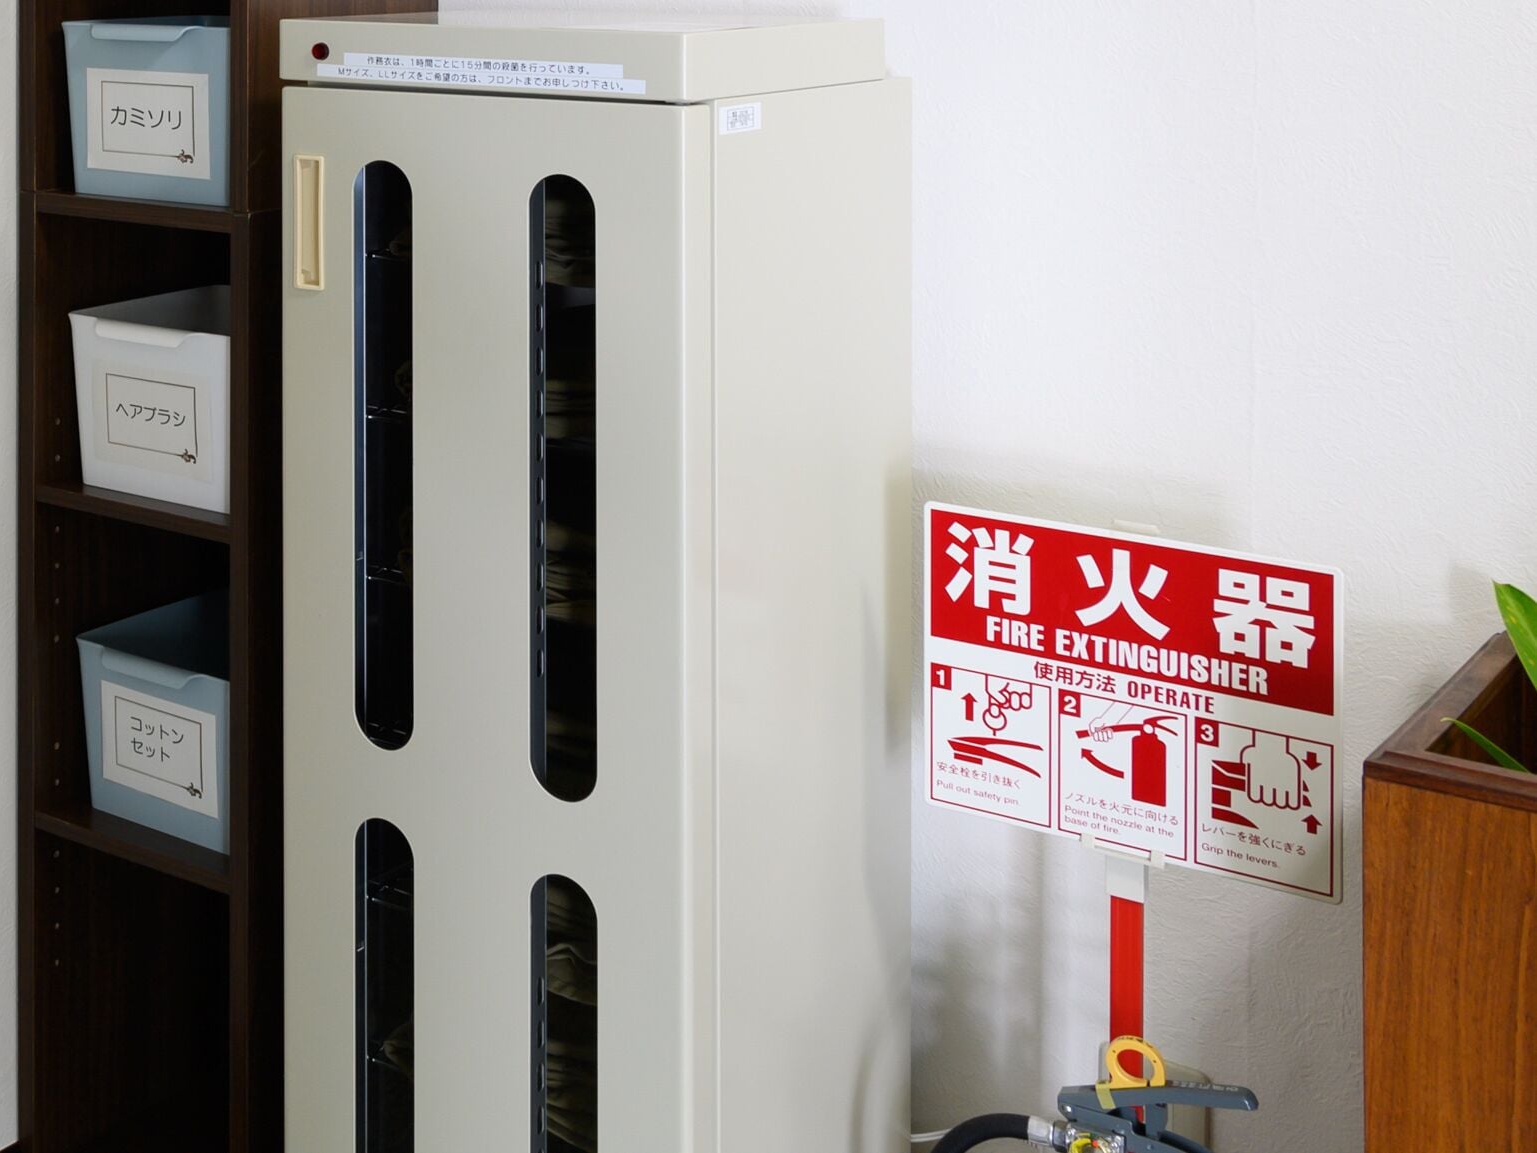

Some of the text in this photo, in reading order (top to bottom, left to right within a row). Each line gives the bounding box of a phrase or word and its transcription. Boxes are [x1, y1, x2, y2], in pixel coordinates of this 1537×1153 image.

[110, 105, 182, 131] カミソリ
[116, 403, 186, 428] ヘアブラシ
[944, 521, 1316, 670] 消火器
[986, 615, 1269, 697] FIRE EXTINGUISHER
[936, 669, 946, 687] 1
[1033, 661, 1215, 715] 使用方法 OPERATE
[1063, 696, 1077, 714] 2
[130, 716, 184, 745] コットン
[1200, 723, 1214, 743] 3
[130, 737, 171, 762] セット
[936, 761, 1021, 789] 安全栓を引き抜く
[936, 779, 954, 791] Pull
[956, 785, 971, 794] out
[973, 789, 1001, 803] safety
[1064, 805, 1174, 838] Point the nozzle at the
[1065, 792, 1179, 826] ノズルを火元に向ける
[1064, 815, 1088, 827] base
[1090, 822, 1101, 830] of
[1201, 823, 1307, 856] レバーを強くにぎる
[1201, 842, 1224, 856] Grip
[1226, 847, 1243, 860] the
